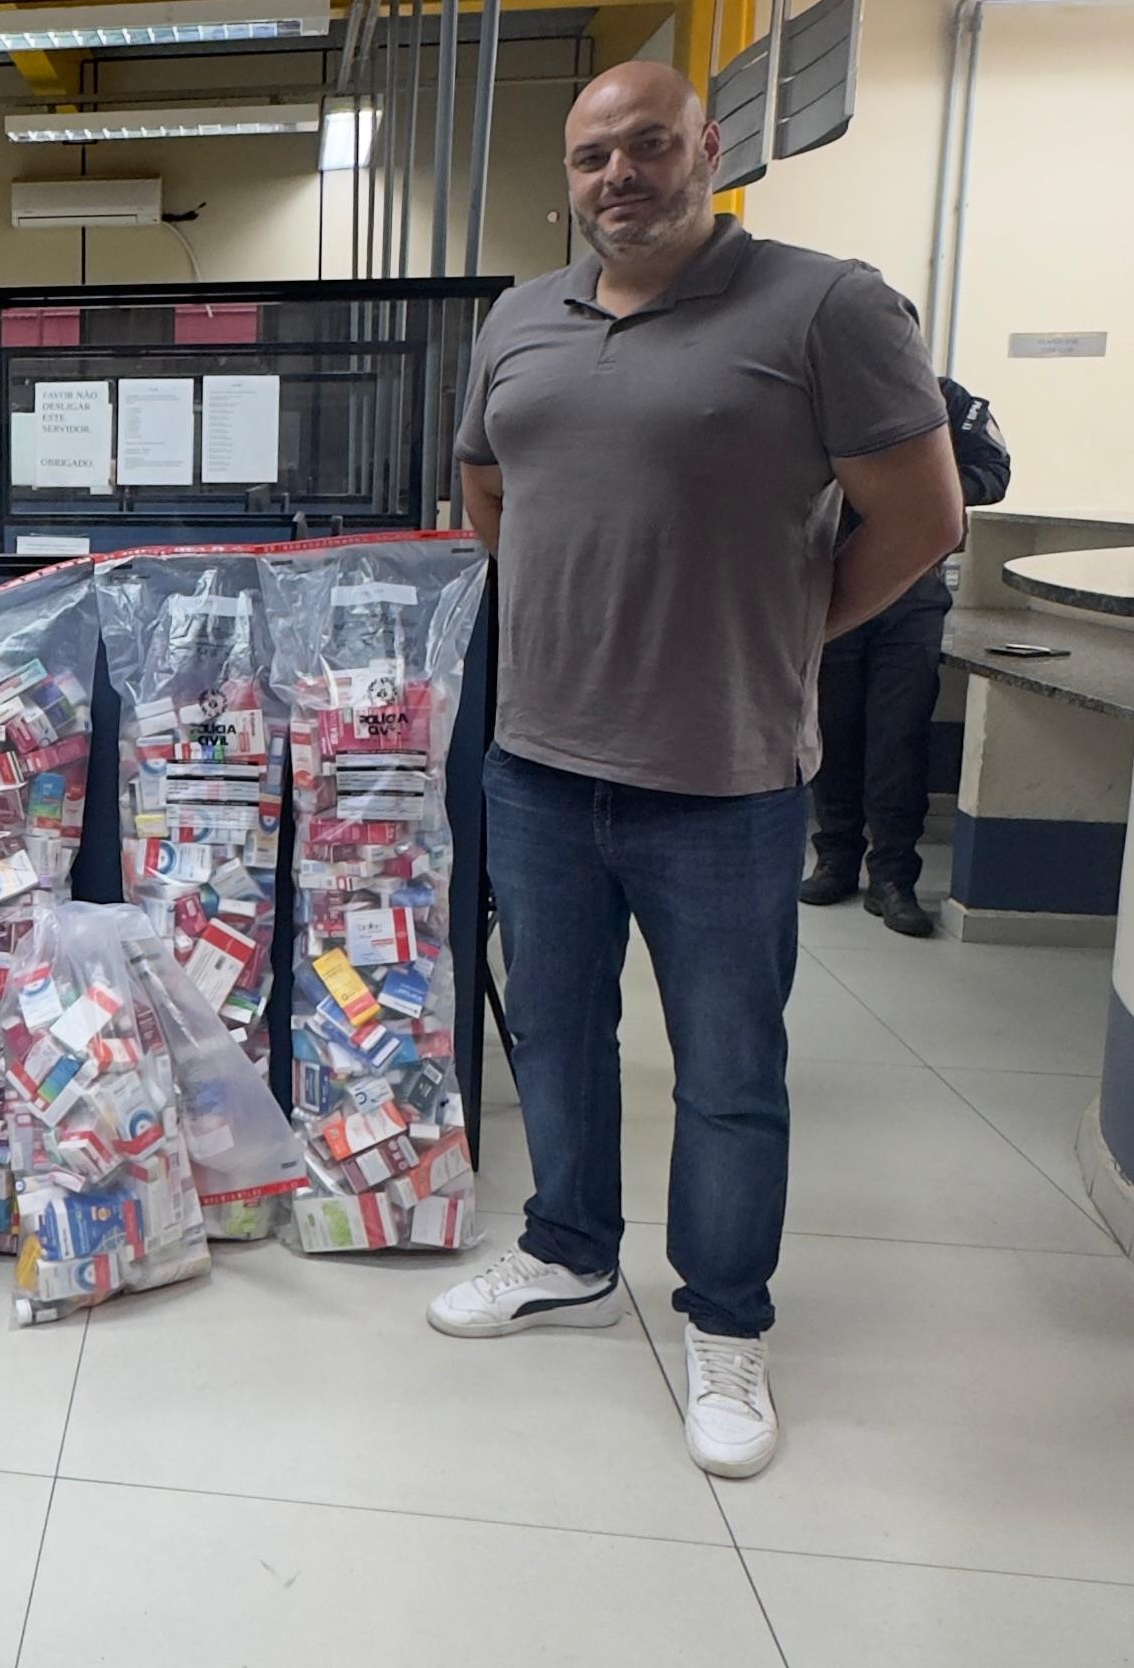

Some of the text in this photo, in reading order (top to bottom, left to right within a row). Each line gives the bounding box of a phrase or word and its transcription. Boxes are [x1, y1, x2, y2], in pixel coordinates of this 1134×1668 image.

[42, 402, 91, 411] DESLIGAR
[42, 414, 66, 422] ESTE
[368, 725, 402, 736] CIV
[198, 735, 229, 746] CIVIL
